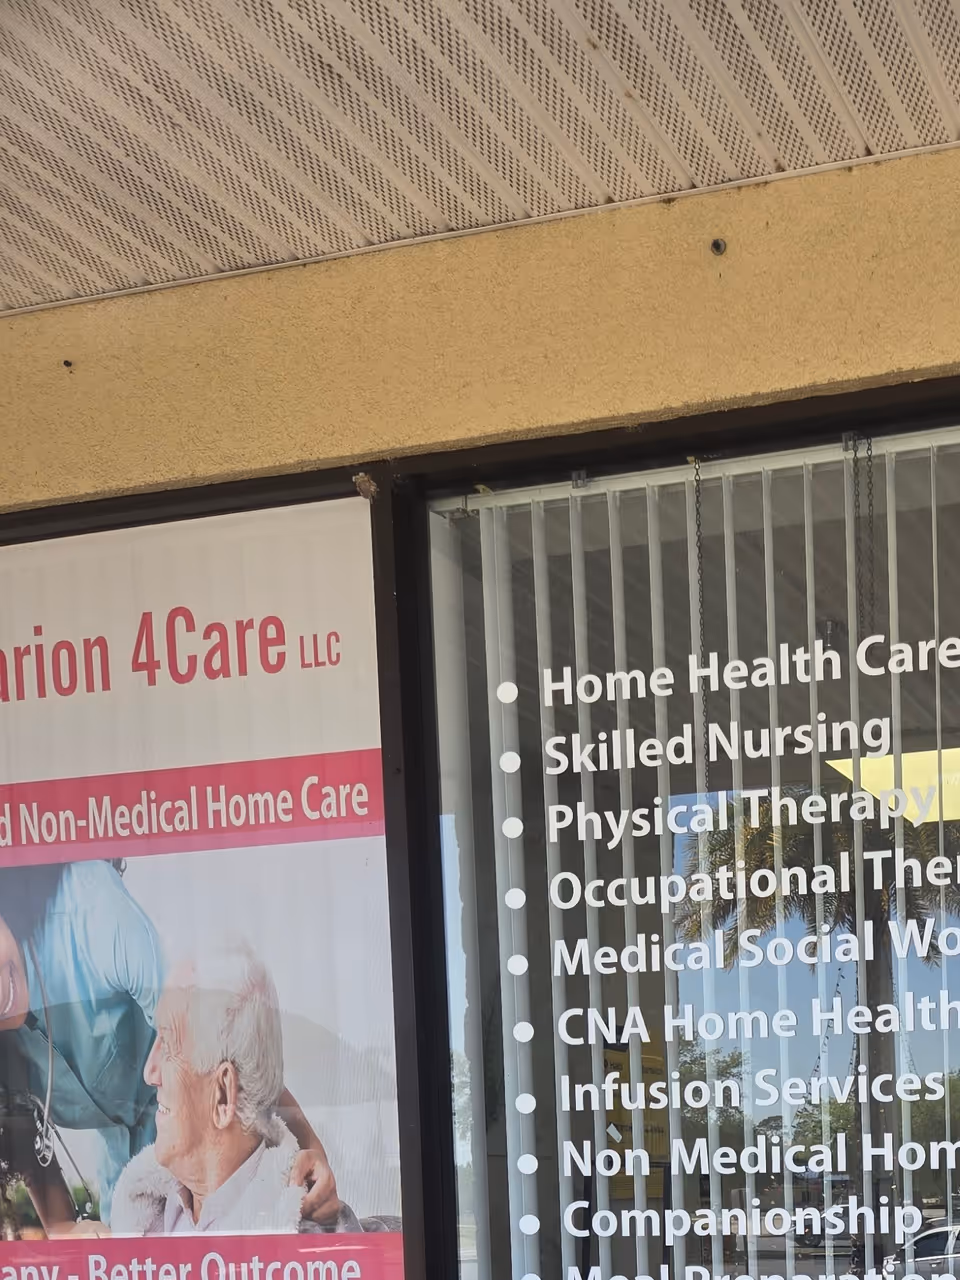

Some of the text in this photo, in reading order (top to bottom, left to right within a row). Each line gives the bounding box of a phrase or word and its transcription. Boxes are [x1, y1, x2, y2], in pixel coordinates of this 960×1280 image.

[131, 606, 286, 687] 4Care
[300, 631, 341, 669] LLC
[543, 664, 674, 707] Home
[690, 641, 841, 695] Health
[545, 714, 892, 776] Skilled Nursing
[19, 786, 198, 845] Non-Medical
[207, 785, 293, 829] Home
[301, 776, 369, 820] Care
[548, 779, 936, 849] Physical Therapy
[549, 852, 849, 913] Occupational
[553, 929, 724, 977] Medical
[740, 922, 873, 967] Social
[557, 1006, 651, 1045] CNA
[664, 1001, 797, 1043] Home
[560, 1063, 945, 1112] Infusion Services
[563, 1140, 649, 1177] Non
[670, 1134, 848, 1175] Medical
[563, 1196, 923, 1245] Companionship
